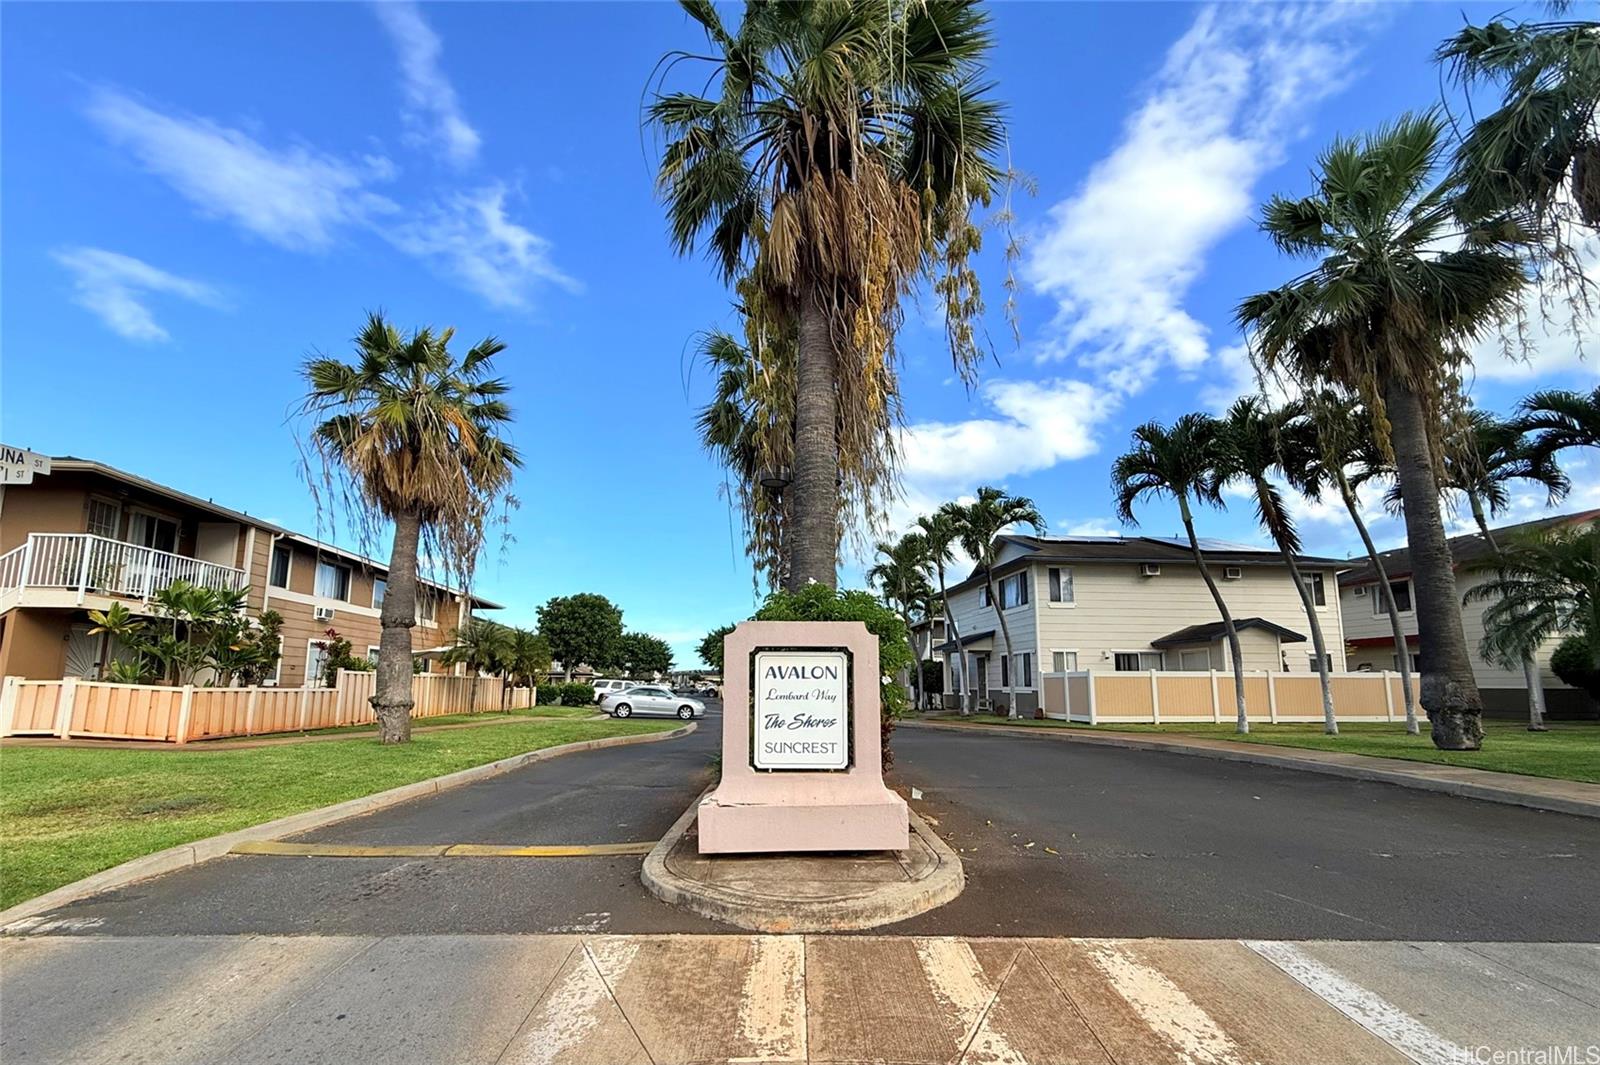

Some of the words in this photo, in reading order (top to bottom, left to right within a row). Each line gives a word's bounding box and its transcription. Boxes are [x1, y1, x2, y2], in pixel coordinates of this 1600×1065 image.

[34, 459, 43, 467] ST
[16, 470, 24, 478] ST
[765, 666, 837, 680] AVALON
[765, 688, 809, 701] Lombard
[812, 688, 837, 703] Way
[764, 713, 786, 730] The
[787, 713, 837, 730] Shores
[765, 742, 837, 754] SUNCREST
